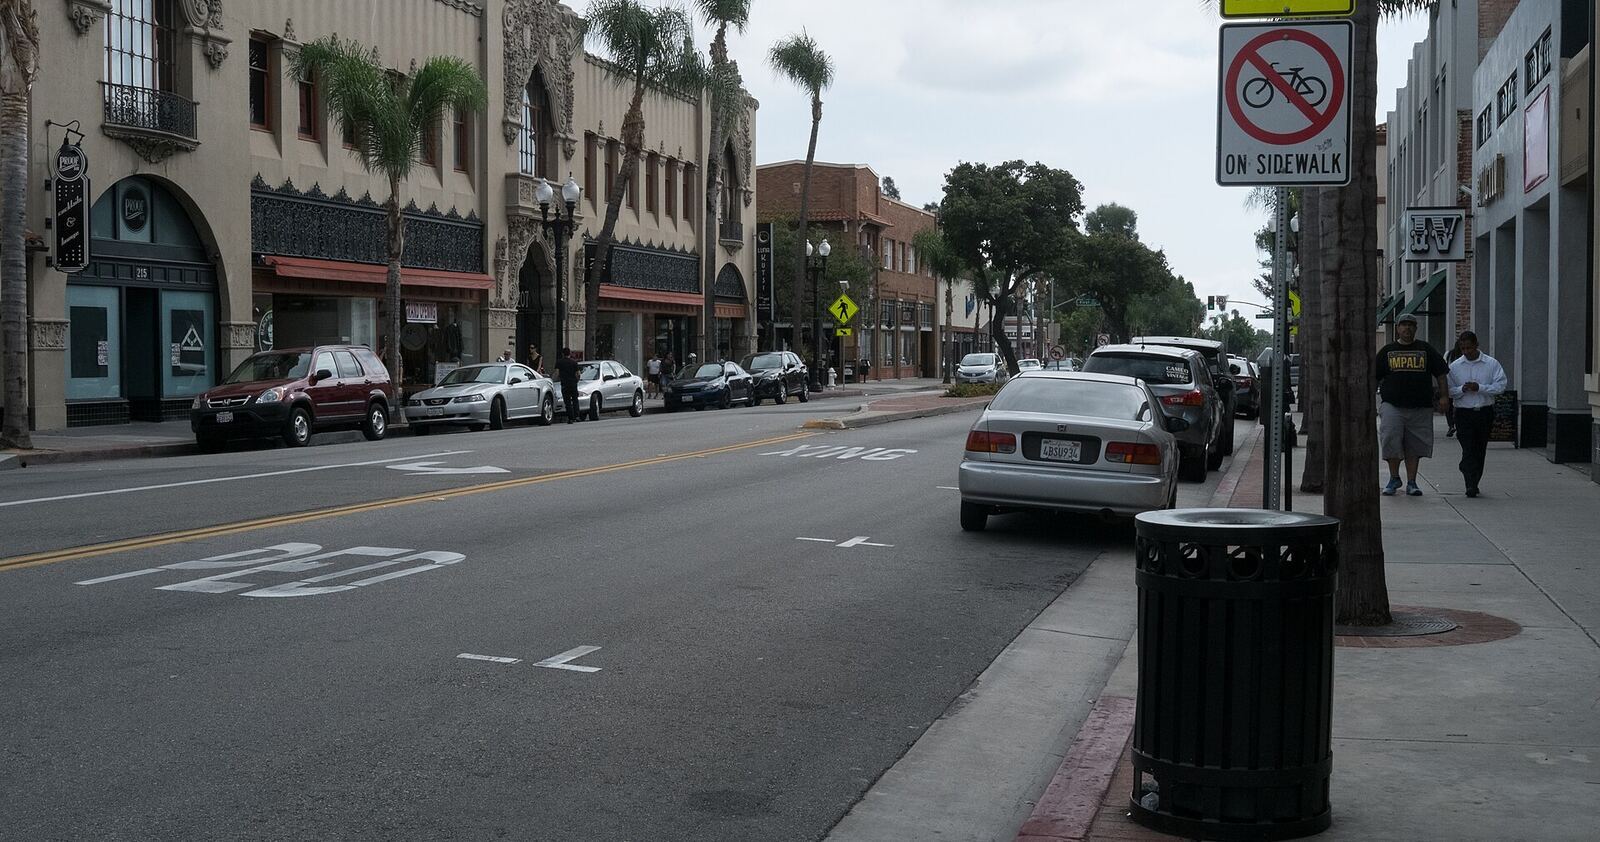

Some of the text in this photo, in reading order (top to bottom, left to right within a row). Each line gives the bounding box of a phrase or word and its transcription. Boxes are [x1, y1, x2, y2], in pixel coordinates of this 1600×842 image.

[59, 155, 79, 169] PROOF
[1225, 153, 1341, 174] ON SIDEWALK
[125, 198, 145, 216] PROOF
[1410, 214, 1462, 254] IV
[136, 267, 148, 278] 215
[1389, 356, 1425, 369] IMPALA
[757, 444, 918, 461] XING
[1043, 446, 1078, 458] 4BSU934
[73, 542, 467, 598] PED
